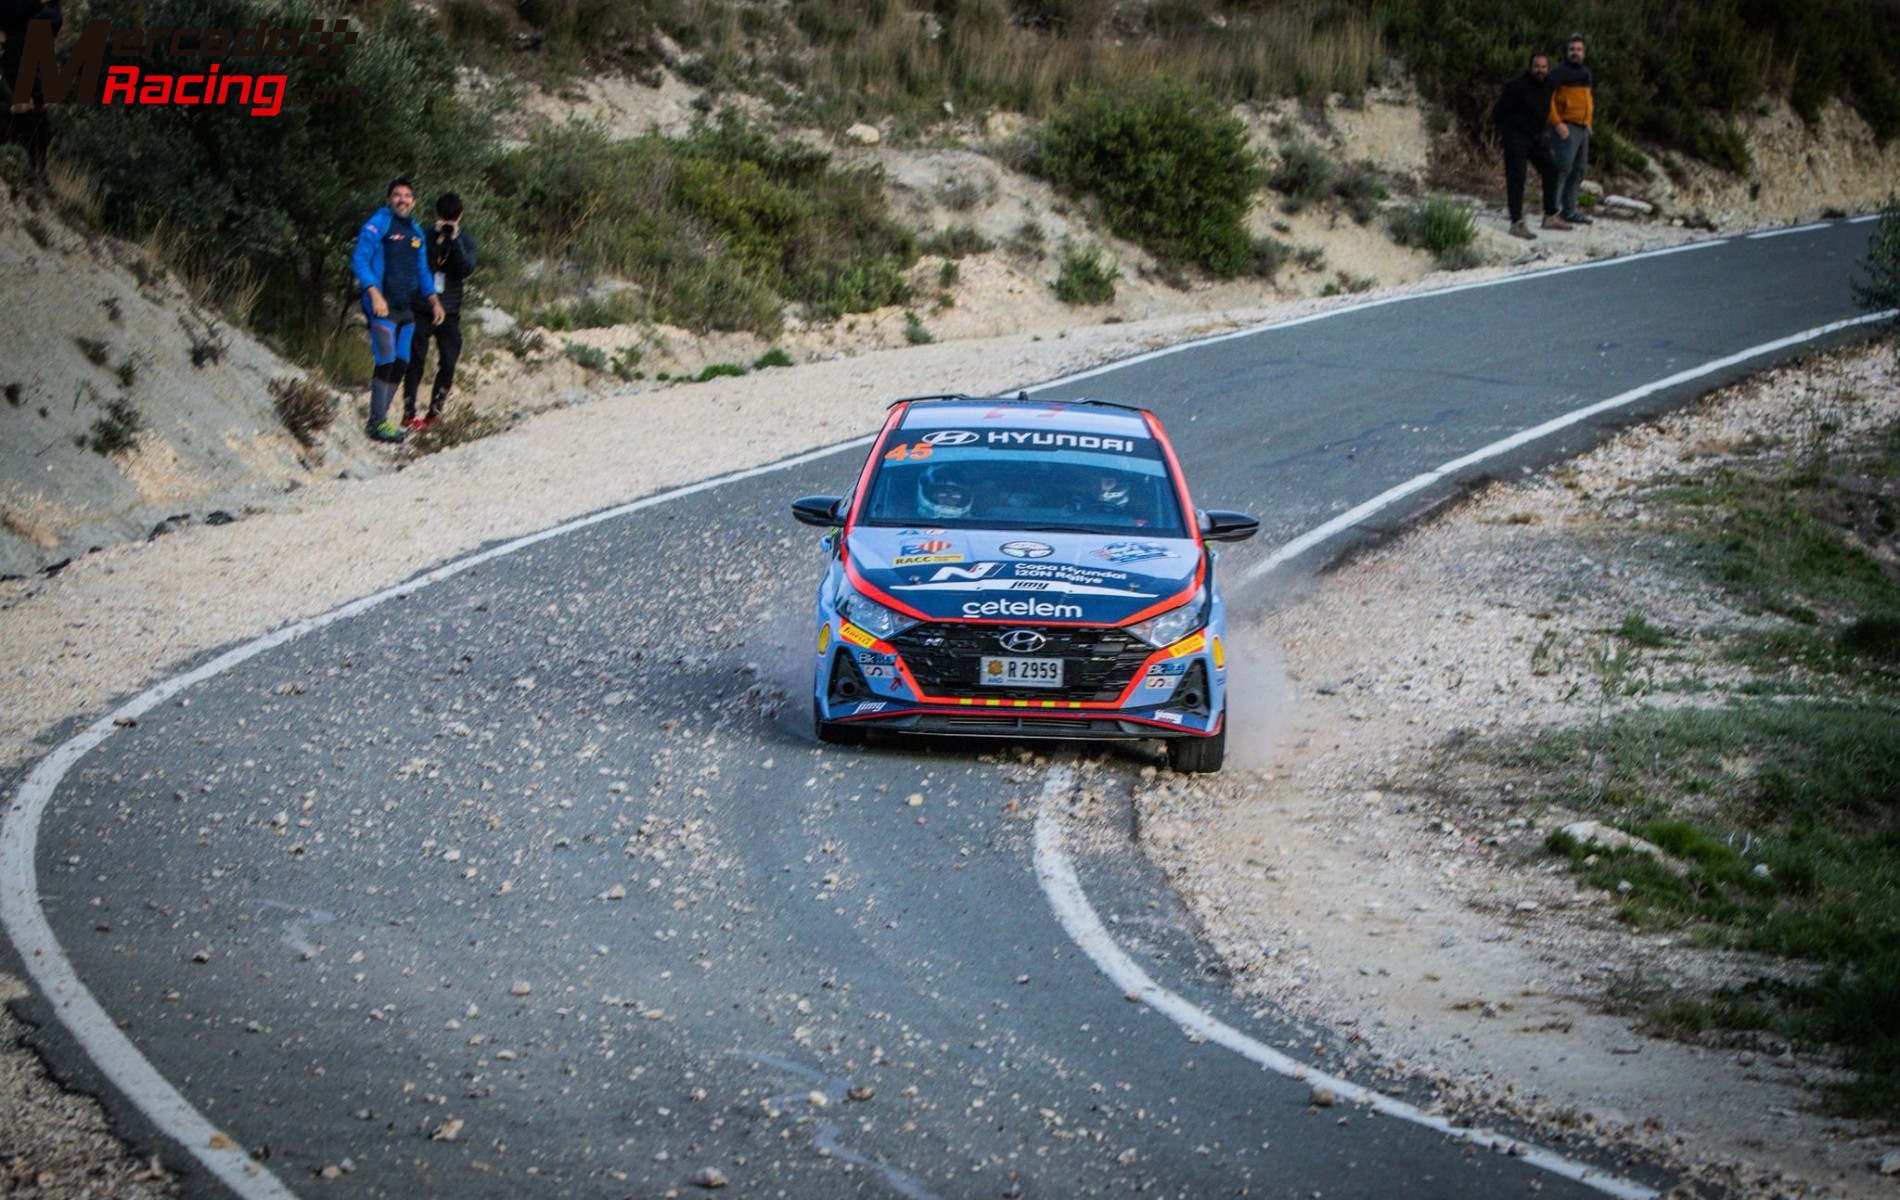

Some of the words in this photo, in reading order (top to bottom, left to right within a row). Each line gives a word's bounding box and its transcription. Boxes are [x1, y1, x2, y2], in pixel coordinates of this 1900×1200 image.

[884, 441, 932, 461] 45
[987, 431, 1134, 452] HYUNDAI
[895, 555, 932, 565] RACC
[1014, 562, 1058, 572] Copa
[1060, 565, 1128, 580] Hyundai
[1054, 571, 1103, 584] Rallye
[962, 598, 1083, 618] cetelem
[1008, 661, 1017, 678] R
[1020, 662, 1058, 680] 2959
